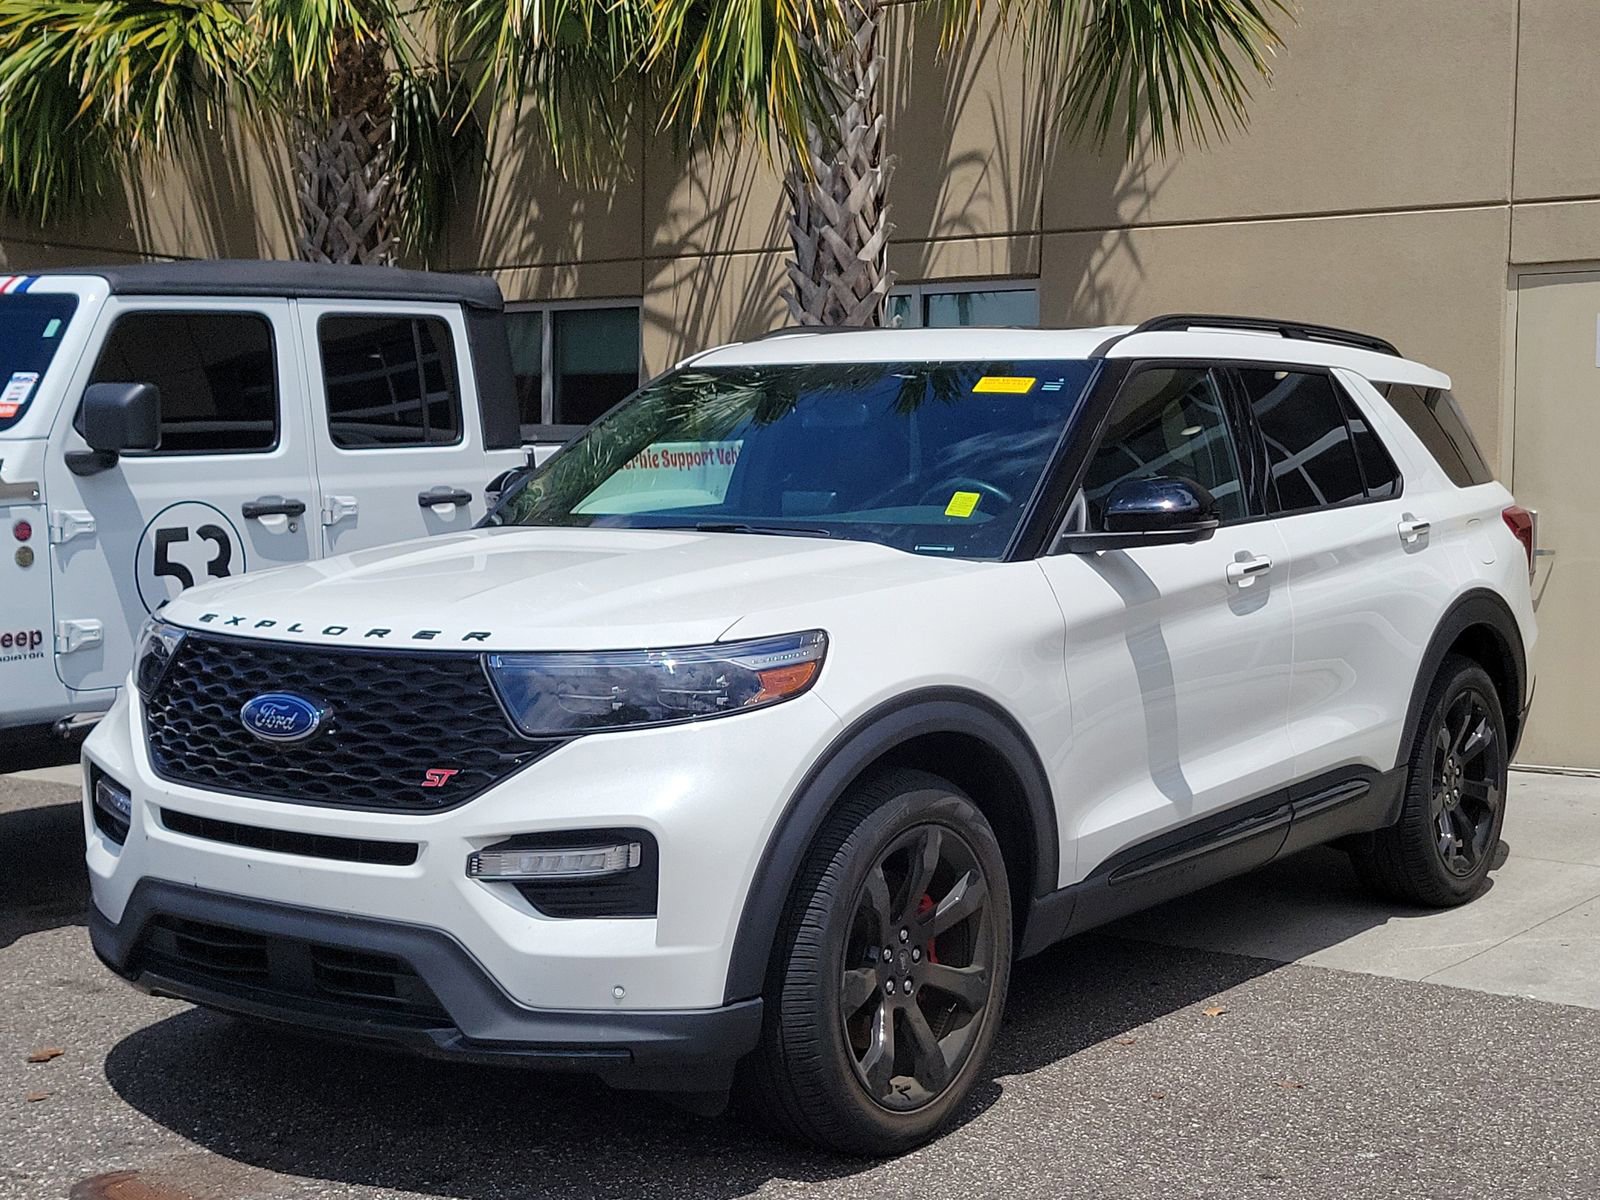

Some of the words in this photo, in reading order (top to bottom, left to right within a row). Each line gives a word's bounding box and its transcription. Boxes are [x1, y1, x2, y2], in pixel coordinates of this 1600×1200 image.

[661, 447, 714, 471] Support
[716, 445, 741, 465] Veh
[153, 524, 232, 592] 53
[0, 630, 43, 650] eep
[199, 613, 492, 642] EXPLORER
[254, 702, 299, 730] Ford
[421, 768, 459, 787] ST
